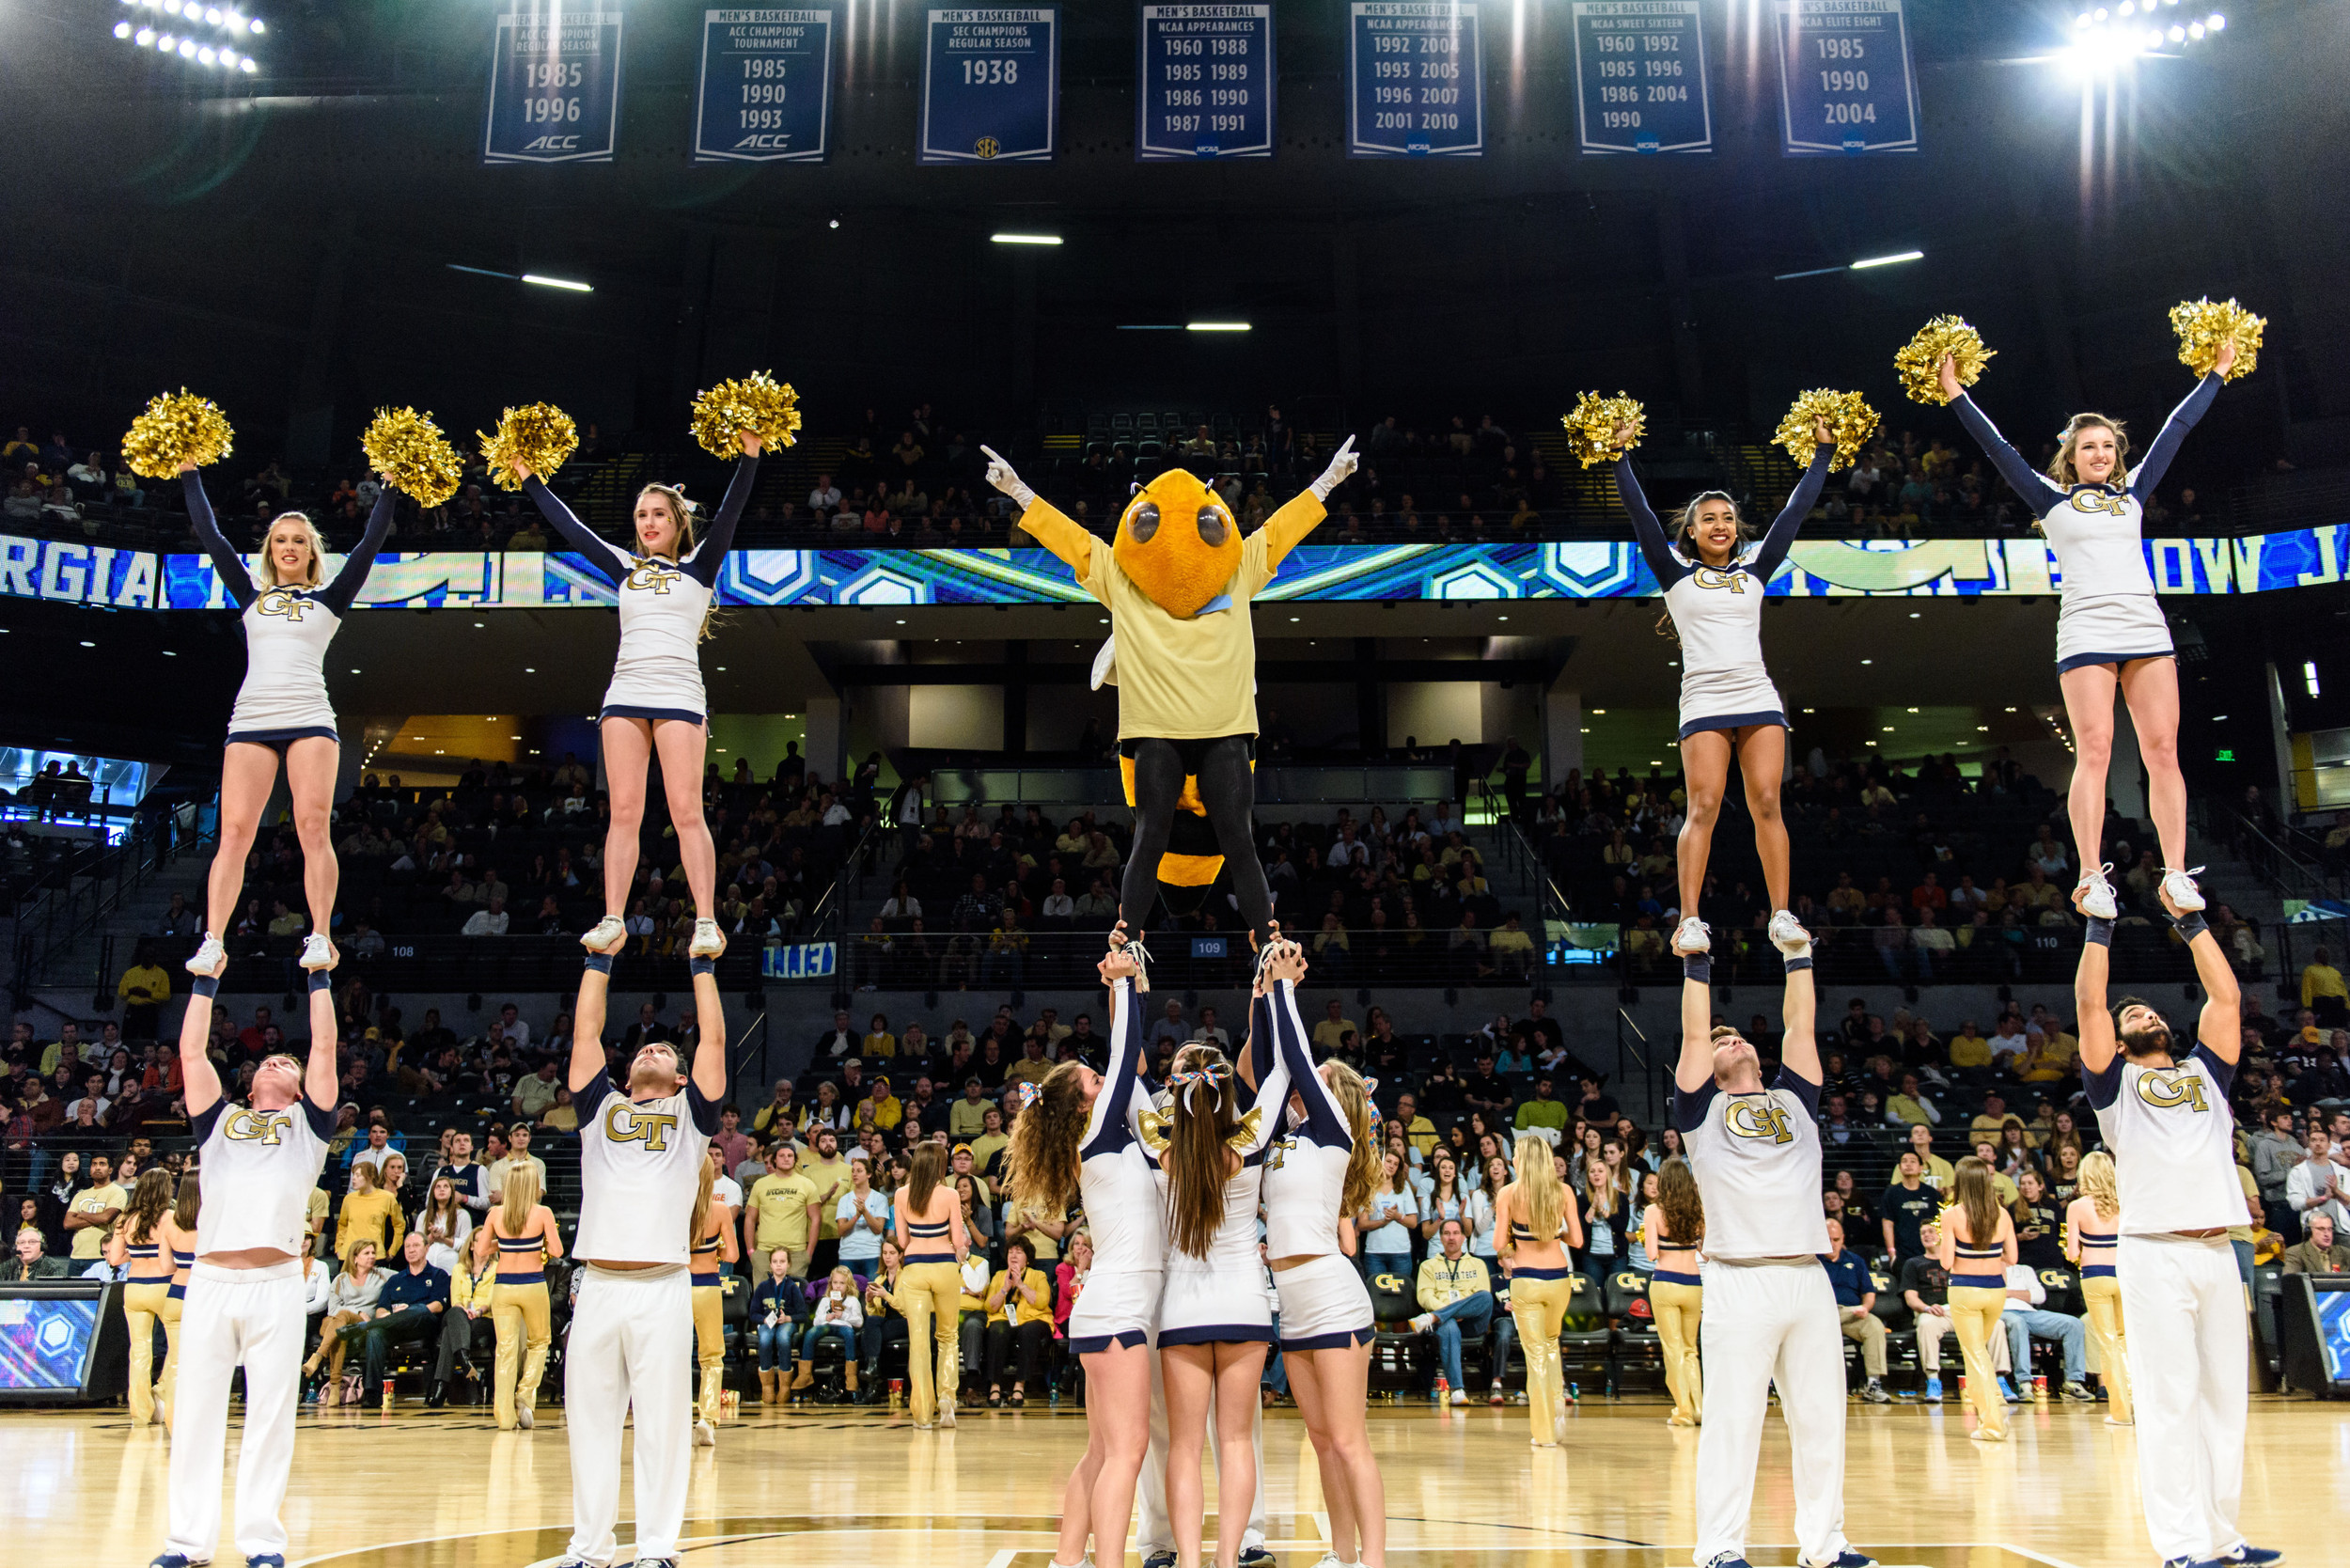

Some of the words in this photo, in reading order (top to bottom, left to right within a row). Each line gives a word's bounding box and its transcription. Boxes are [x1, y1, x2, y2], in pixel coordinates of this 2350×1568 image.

[1157, 7, 1188, 17] MEN'S
[1193, 7, 1256, 17] BASKETBALL
[1365, 5, 1397, 15] MEN'S
[1587, 4, 1618, 14] MEN'S
[1622, 3, 1685, 13] BASKETBALL
[1825, 1, 1888, 11] BASKETBALL
[719, 11, 751, 22] MEN'S
[755, 11, 817, 22] BASKETBALL
[942, 11, 974, 22] MEN'S
[978, 11, 1041, 22] BASKETBALL
[1367, 19, 1392, 29] NCAA
[1591, 19, 1614, 28] NCAA
[1618, 19, 1645, 28] SWEET
[1648, 18, 1684, 28] SIXTEEN
[1826, 17, 1851, 26] ELITE
[1854, 16, 1881, 26] EIGHT
[729, 26, 745, 37] ACC
[749, 26, 805, 37] CHAMPIONS
[953, 26, 969, 36] SEC
[972, 26, 1027, 36] CHAMPIONS
[1159, 22, 1183, 32] NCAA
[1187, 22, 1255, 32] APPEARANCES
[562, 40, 599, 51] SEASON
[735, 39, 798, 48] TOURNAMENT
[949, 38, 992, 48] REGULAR
[995, 38, 1031, 48] SEASON
[1166, 39, 1202, 55] 1960
[1211, 39, 1247, 55] 1988
[1374, 37, 1410, 53] 1992
[1419, 38, 1460, 54] 2004
[1597, 36, 1635, 52] 1960
[1642, 36, 1679, 52] 1992
[1817, 39, 1864, 58] 1985
[526, 63, 582, 87] 1985
[744, 59, 786, 78] 1985
[963, 60, 1018, 85] 1938
[1166, 65, 1201, 81] 1985
[1211, 64, 1247, 81] 1989
[1374, 62, 1410, 78] 1993
[1420, 63, 1459, 79] 2005
[1599, 61, 1636, 77] 1985
[1645, 61, 1683, 77] 1996
[1821, 71, 1869, 91] 1990
[742, 85, 786, 103] 1990
[1166, 90, 1202, 106] 1986
[1211, 89, 1248, 105] 1990
[1375, 87, 1412, 103] 1996
[1421, 87, 1459, 103] 2007
[1601, 86, 1638, 102] 1986
[1647, 86, 1687, 102] 2004
[525, 97, 580, 122] 1996
[1824, 103, 1876, 123] 2004
[740, 110, 782, 129] 1993
[1166, 116, 1200, 132] 1987
[1211, 115, 1246, 131] 1991
[1376, 113, 1412, 129] 2001
[1421, 113, 1458, 130] 2010
[1603, 112, 1641, 128] 1990
[524, 135, 581, 149] ACC
[733, 134, 791, 149] ACC
[977, 138, 997, 158] SEC
[2071, 488, 2128, 516] GT
[627, 564, 682, 594] GT
[1694, 567, 1747, 594] GT
[257, 591, 314, 621] GT
[1198, 943, 1220, 953] 109
[2035, 937, 2058, 948] 110
[393, 947, 415, 957] 108
[2137, 1071, 2209, 1113] GT
[224, 1109, 292, 1145] GT
[606, 1103, 677, 1151] GT
[1726, 1100, 1793, 1144] GT
[1461, 1267, 1478, 1278] TECH
[2040, 1271, 2071, 1289] GT
[1374, 1274, 1404, 1293] GT
[1617, 1273, 1647, 1291] GT
